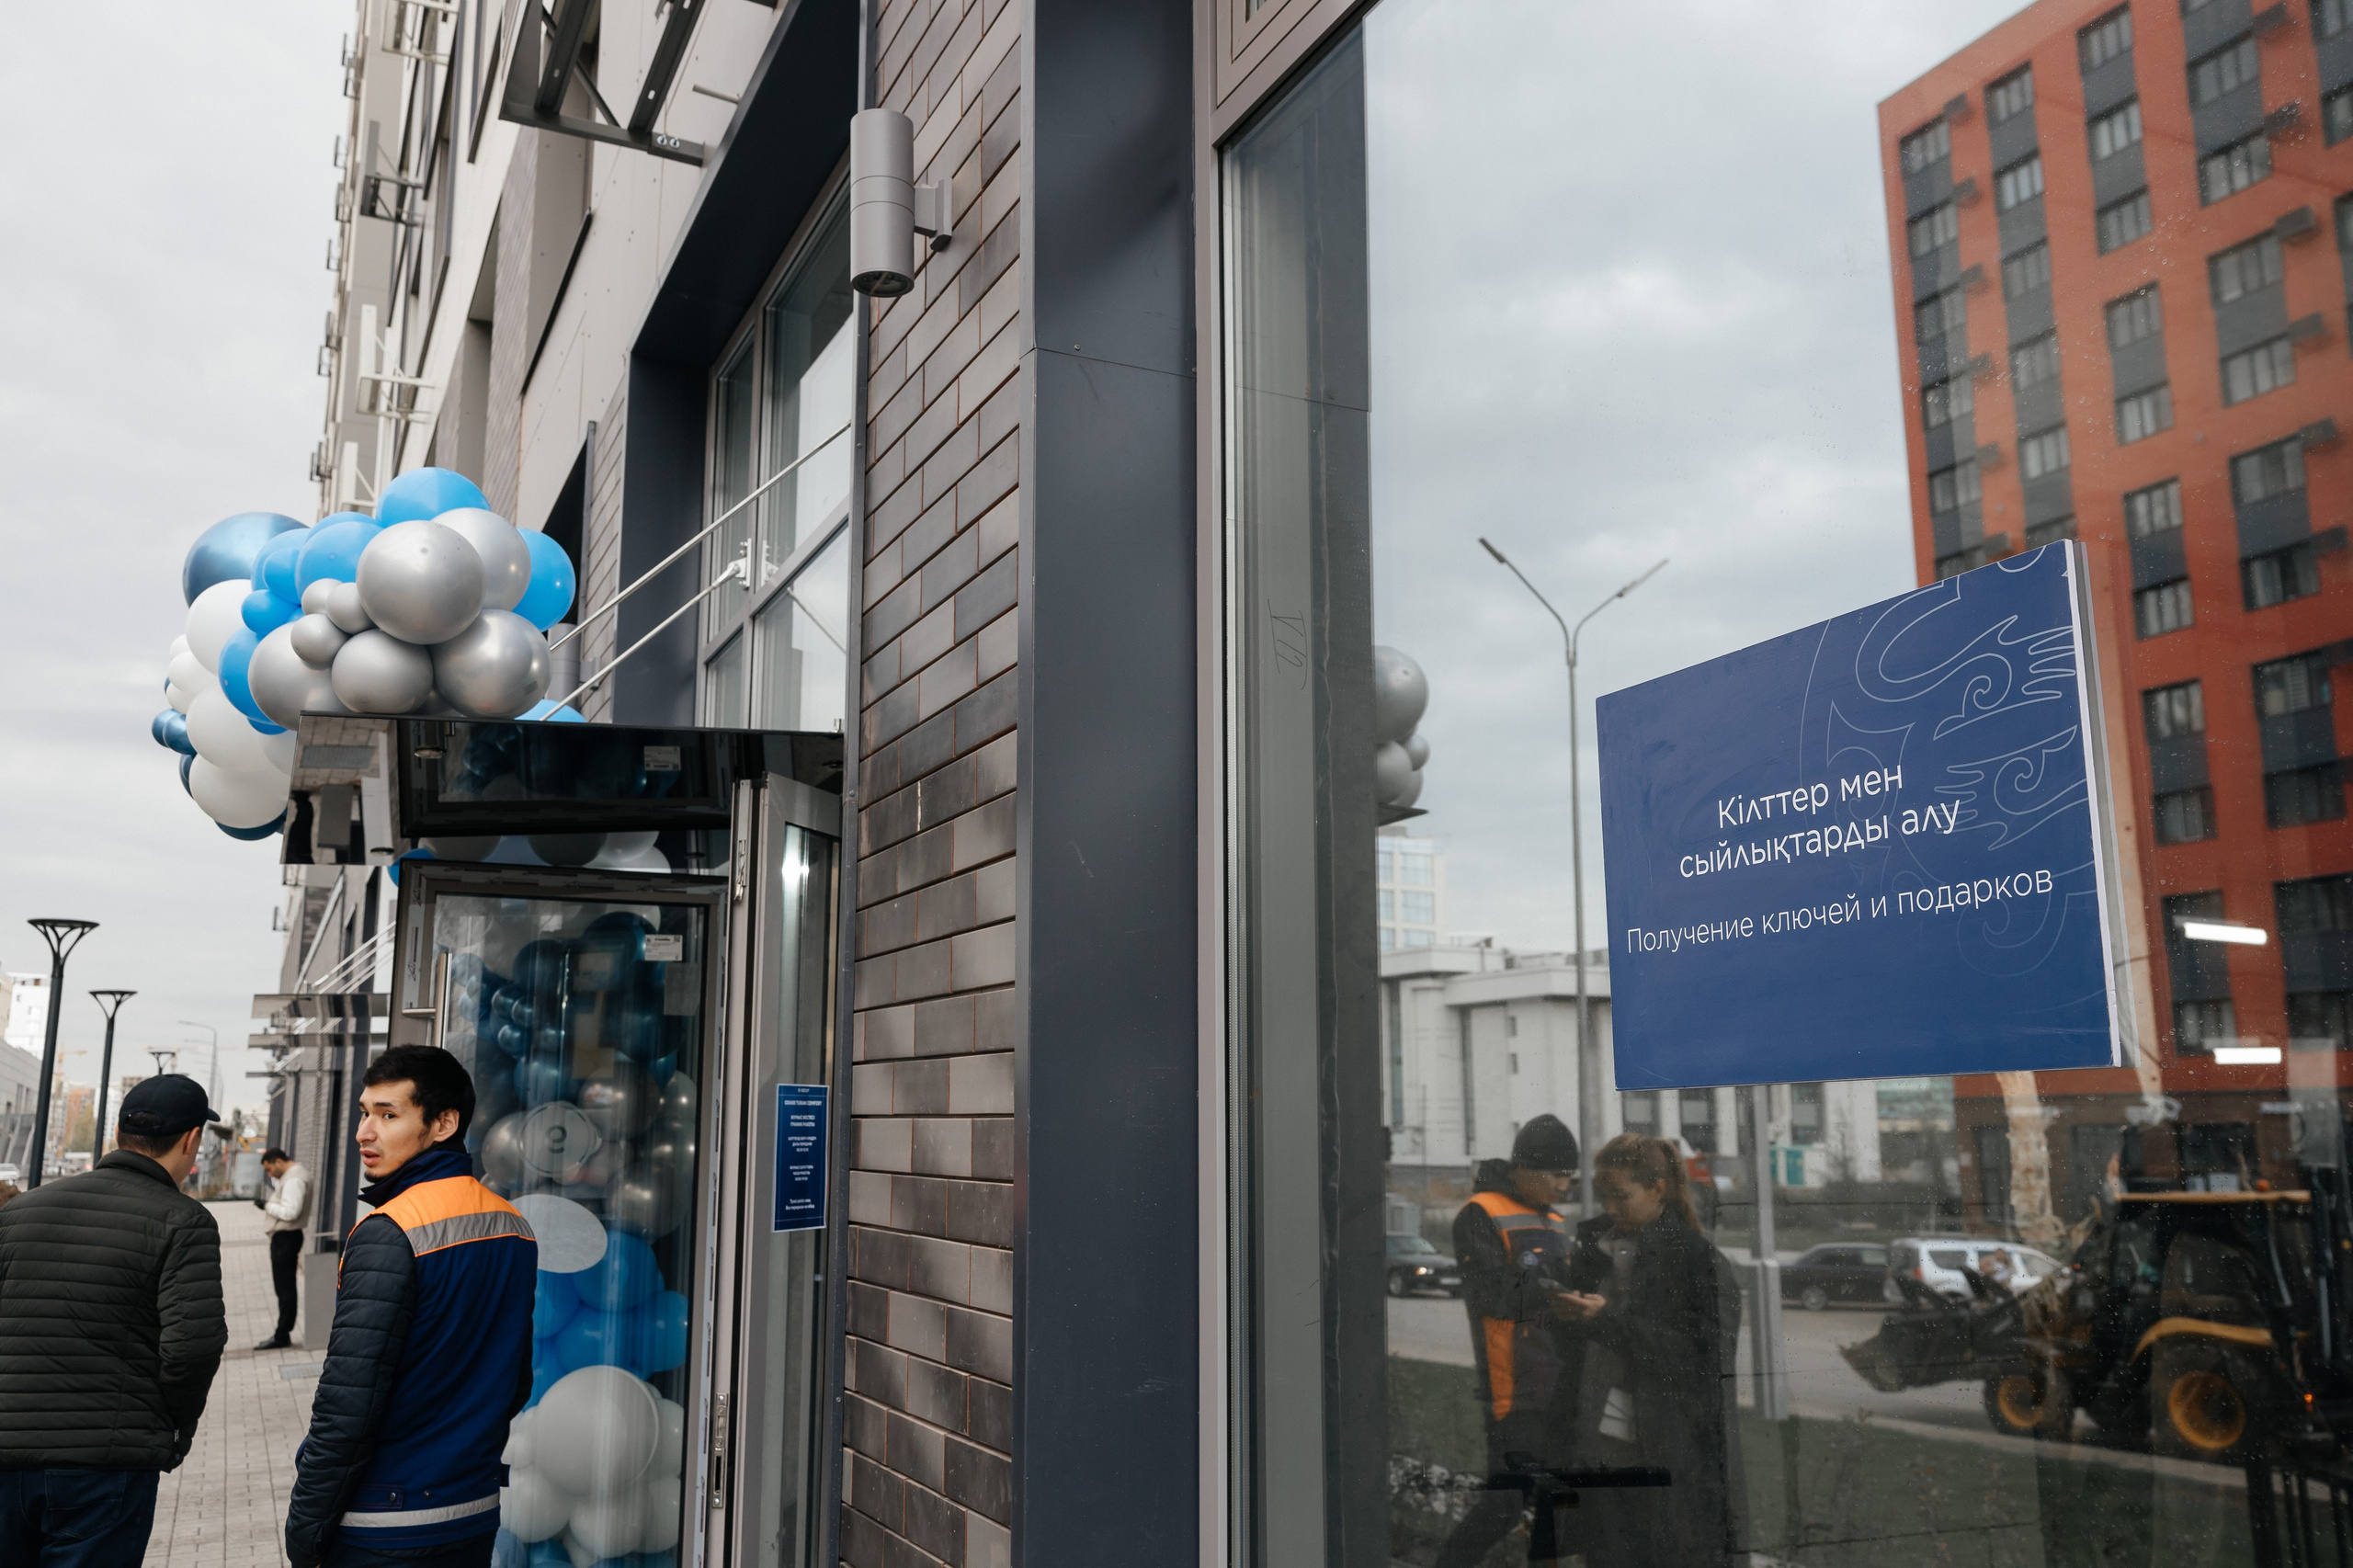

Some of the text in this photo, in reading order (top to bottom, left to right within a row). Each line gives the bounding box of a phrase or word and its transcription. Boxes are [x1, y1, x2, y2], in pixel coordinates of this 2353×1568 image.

[1718, 765, 1903, 829] Кілттер мен
[1680, 800, 1961, 878] сыйлықтарды алу
[1628, 869, 2053, 954] Получение ключей и подарков
